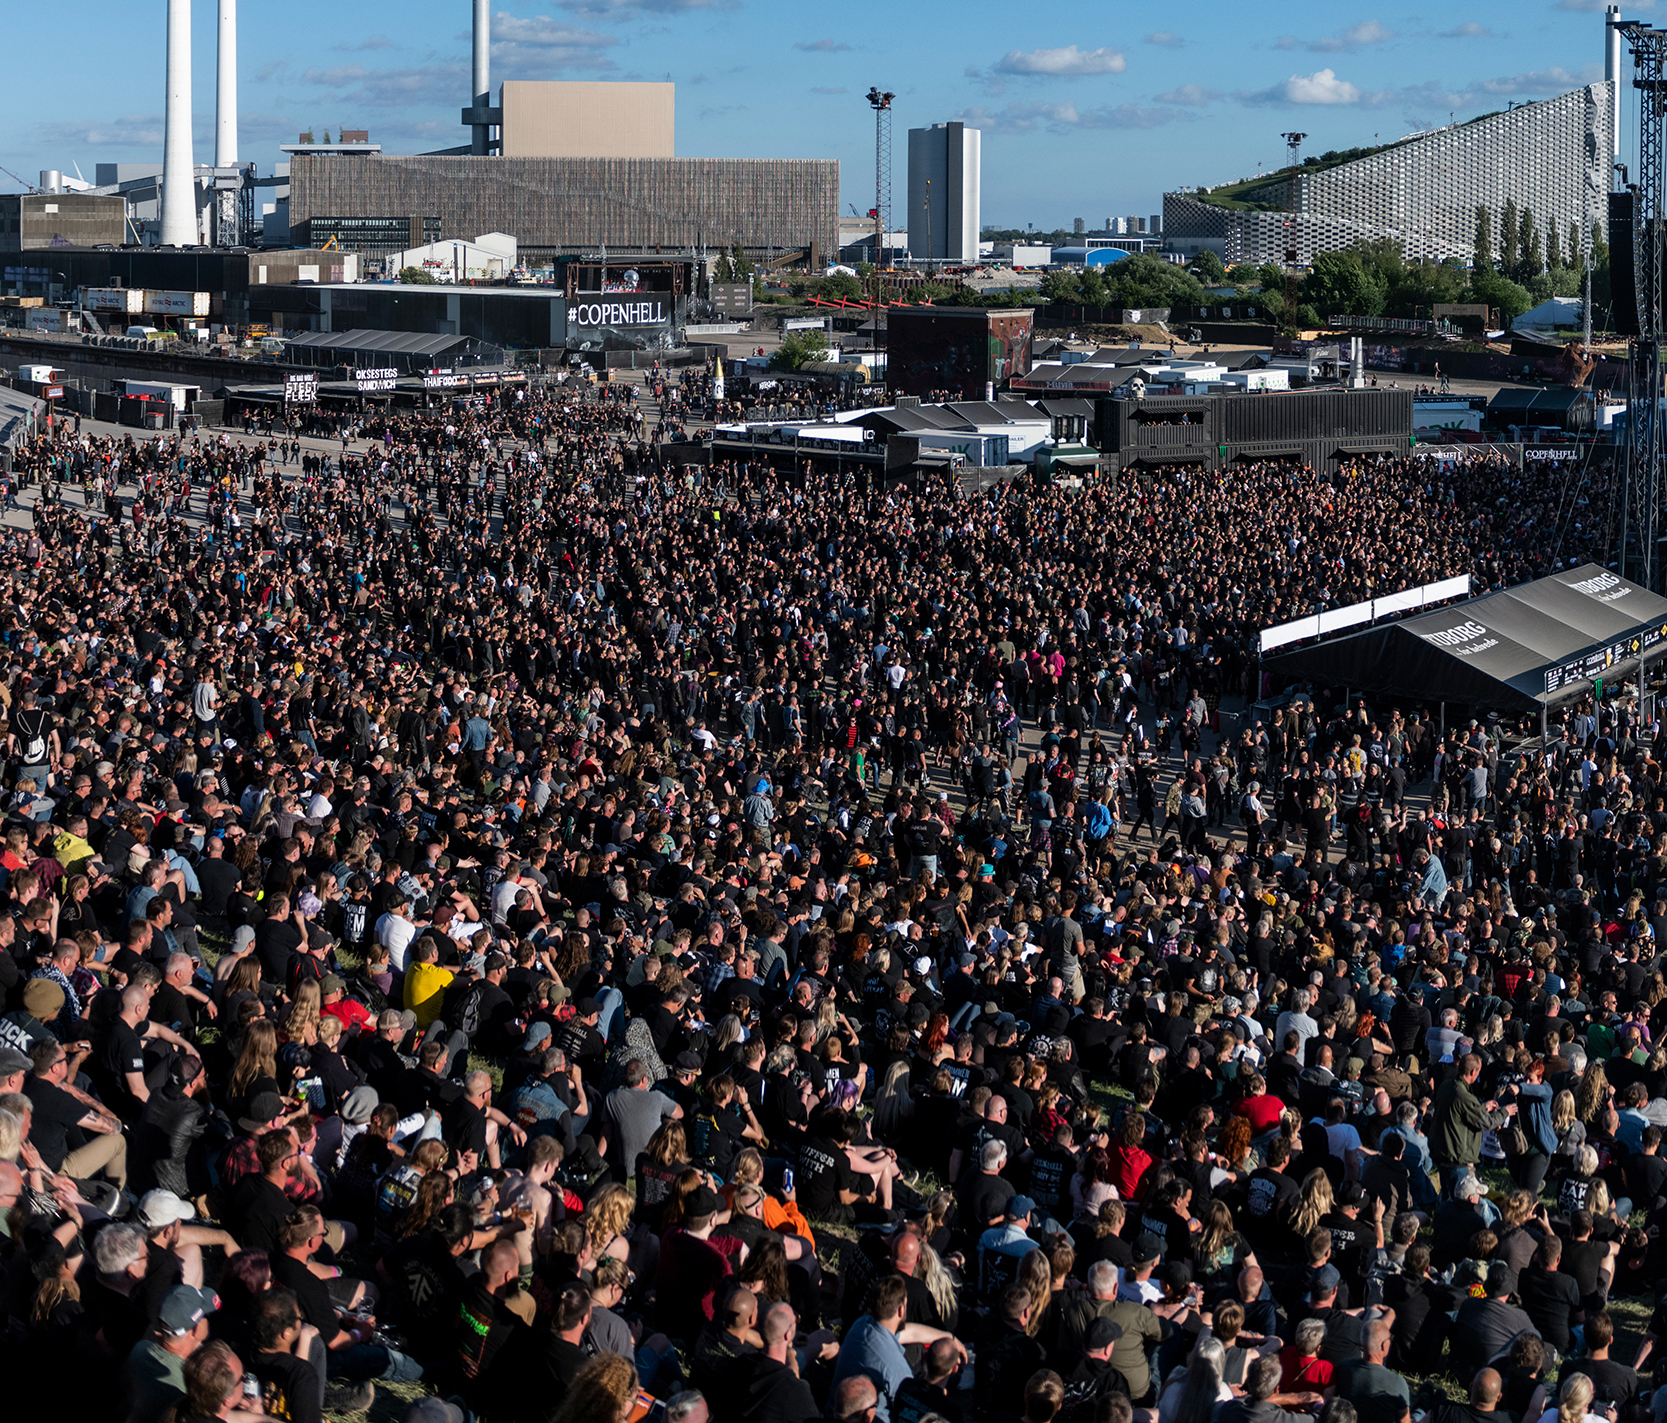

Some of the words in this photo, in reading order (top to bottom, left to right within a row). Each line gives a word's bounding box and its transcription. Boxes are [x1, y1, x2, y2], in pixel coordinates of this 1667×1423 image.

[568, 302, 667, 325] #COPENHELL
[286, 382, 318, 392] STEGT
[1046, 380, 1073, 389] 7-ELEVEN
[1525, 449, 1578, 460] COPENHELL
[1420, 621, 1486, 646] TUBORG
